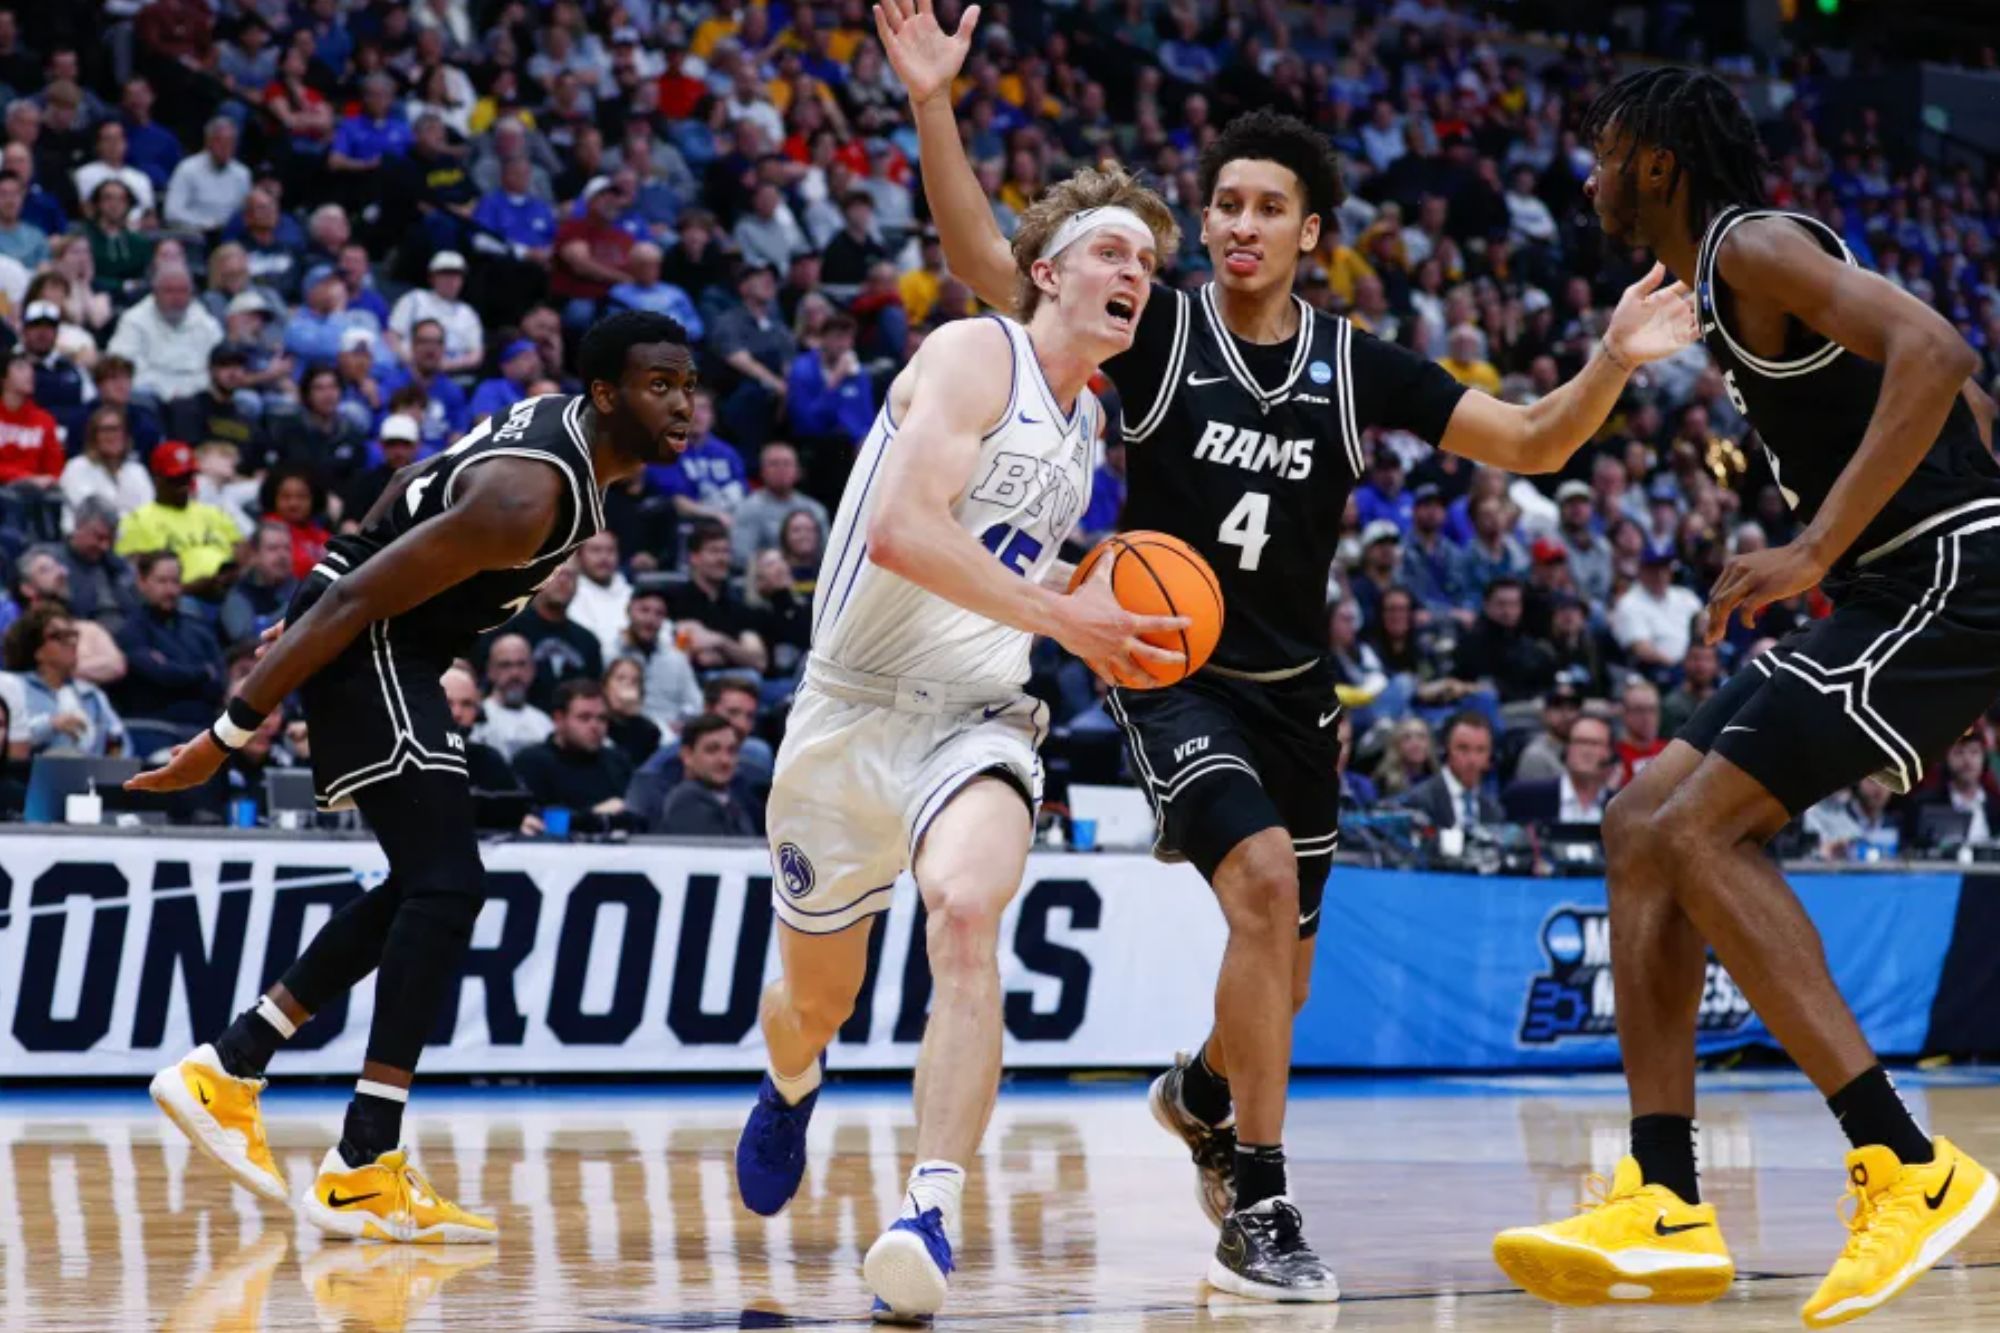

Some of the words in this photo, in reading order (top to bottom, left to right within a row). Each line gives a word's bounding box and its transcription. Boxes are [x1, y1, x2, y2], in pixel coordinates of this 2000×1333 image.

[1193, 419, 1315, 480] RAMS
[970, 451, 1079, 542] BYU
[1217, 491, 1271, 571] 4
[1173, 735, 1210, 763] VCU
[0, 860, 367, 1052] OND
